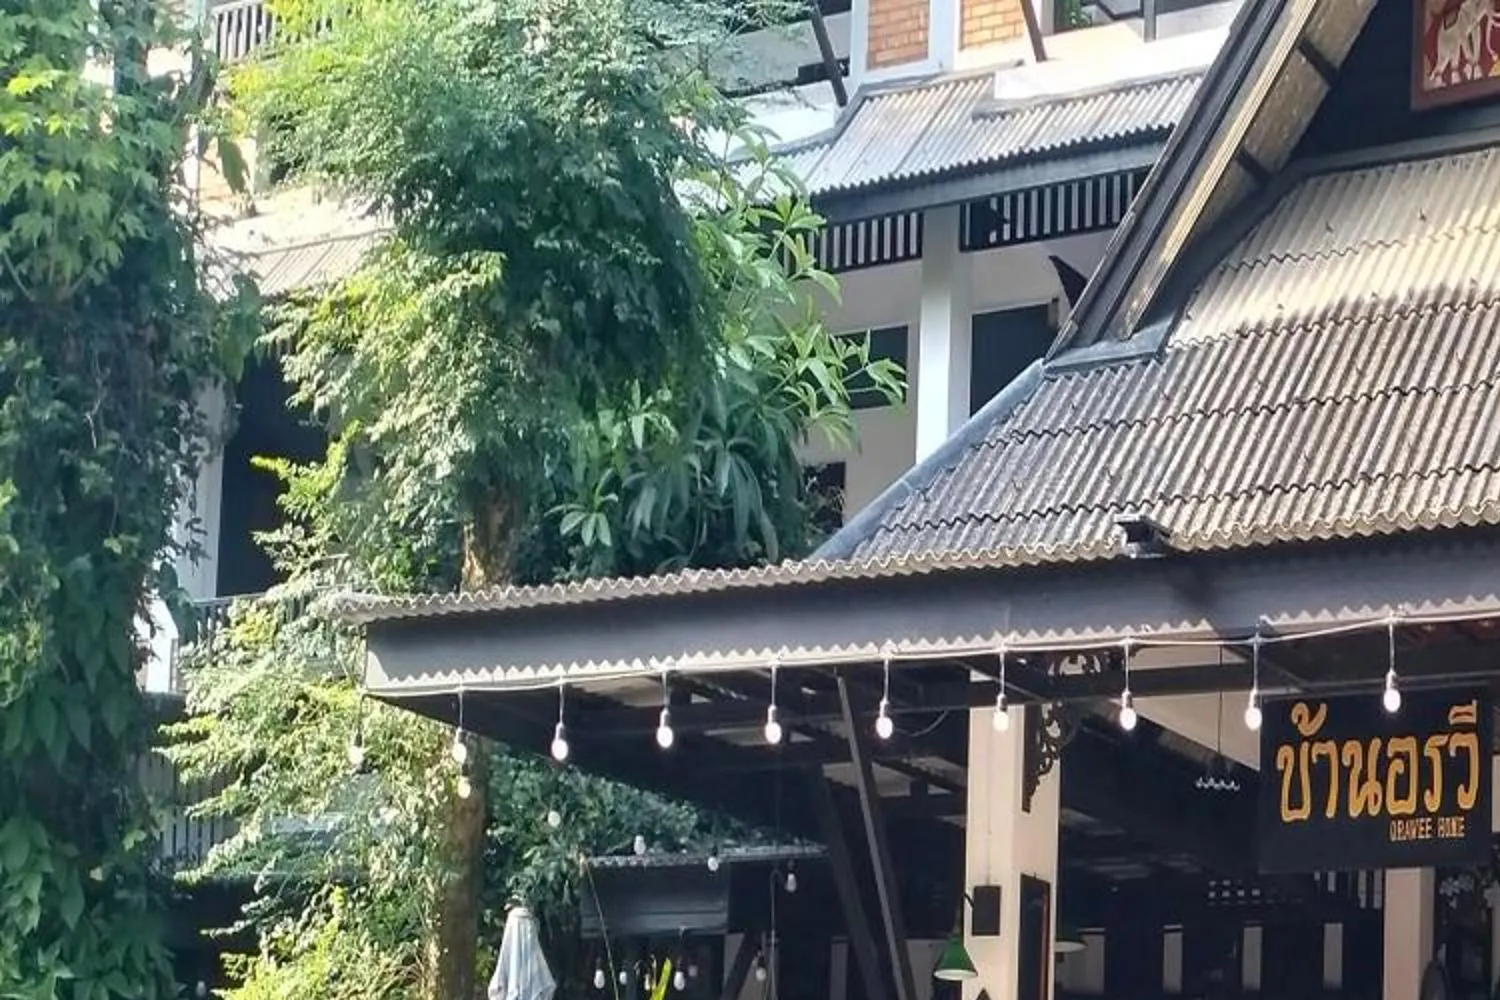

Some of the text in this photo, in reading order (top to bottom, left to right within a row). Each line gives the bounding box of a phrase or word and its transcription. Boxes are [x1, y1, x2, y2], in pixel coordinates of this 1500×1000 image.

[1276, 699, 1480, 822] บ้านอรวี
[1389, 816, 1466, 842] ORAWEE HOME
